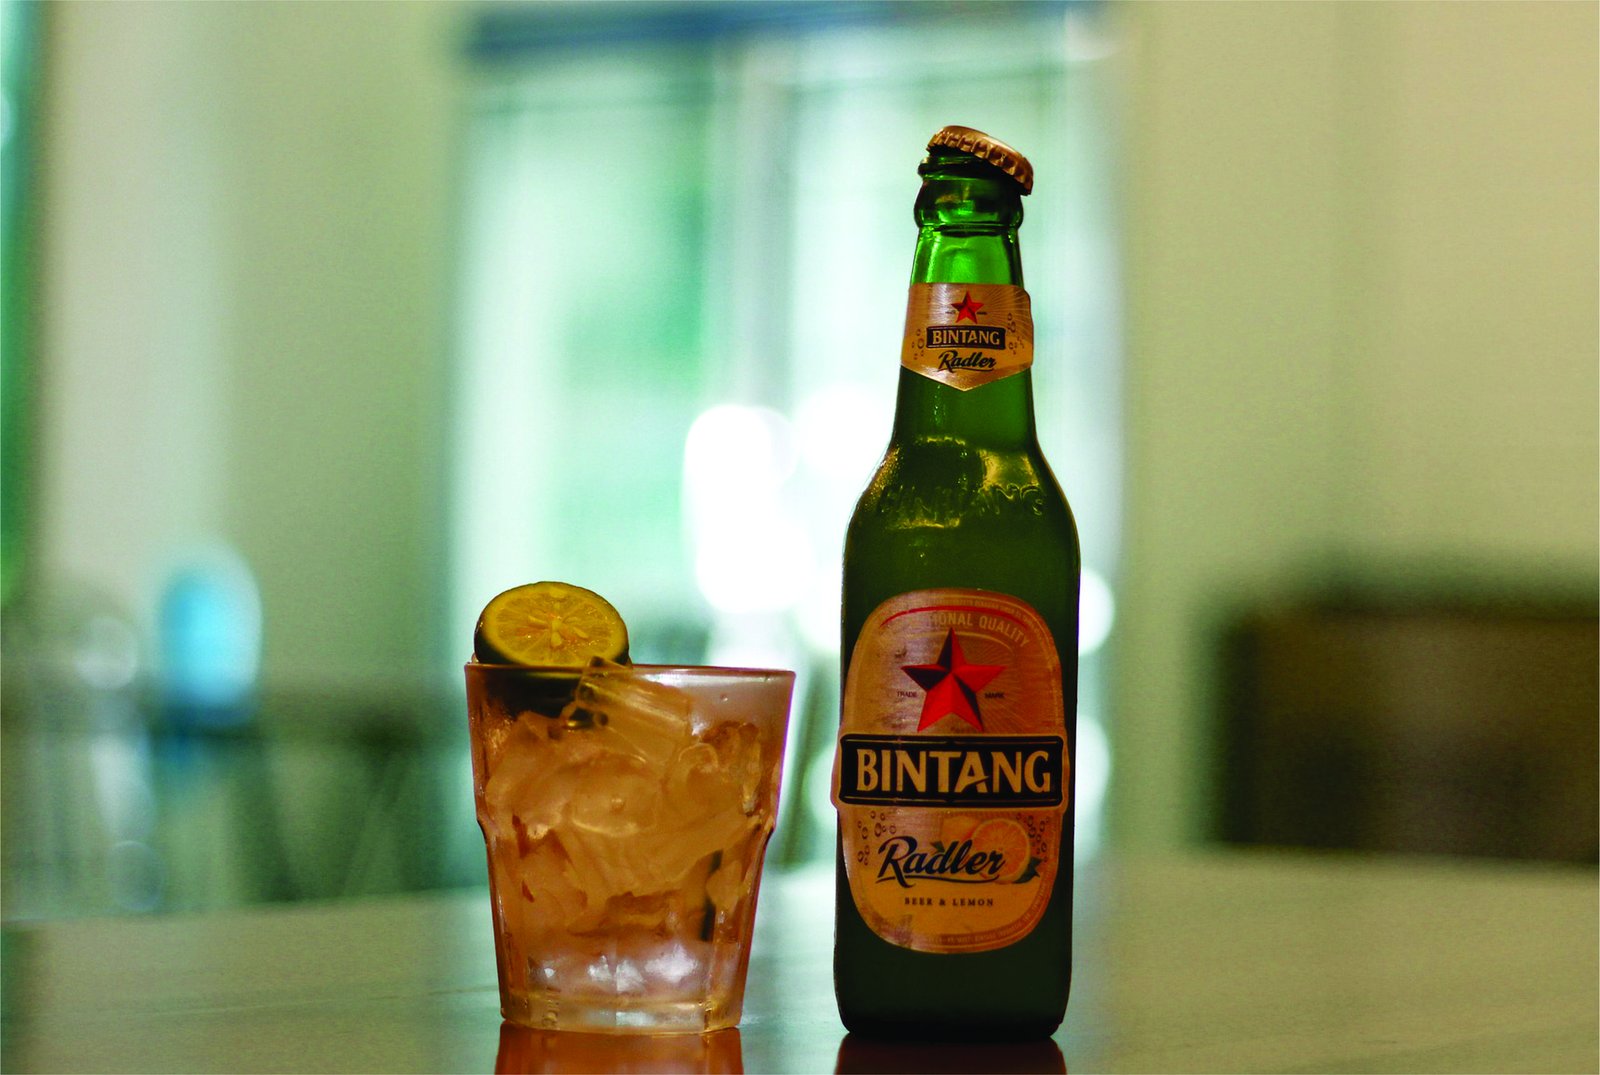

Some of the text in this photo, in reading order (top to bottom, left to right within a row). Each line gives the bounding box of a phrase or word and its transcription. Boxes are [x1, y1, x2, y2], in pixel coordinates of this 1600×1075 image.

[932, 329, 1000, 345] BINTANG
[938, 350, 997, 373] Radler
[979, 615, 1030, 647] QUALITY
[856, 748, 1052, 794] BINTANG
[875, 836, 1007, 888] Radler
[904, 897, 994, 906] BEER & LEMON
